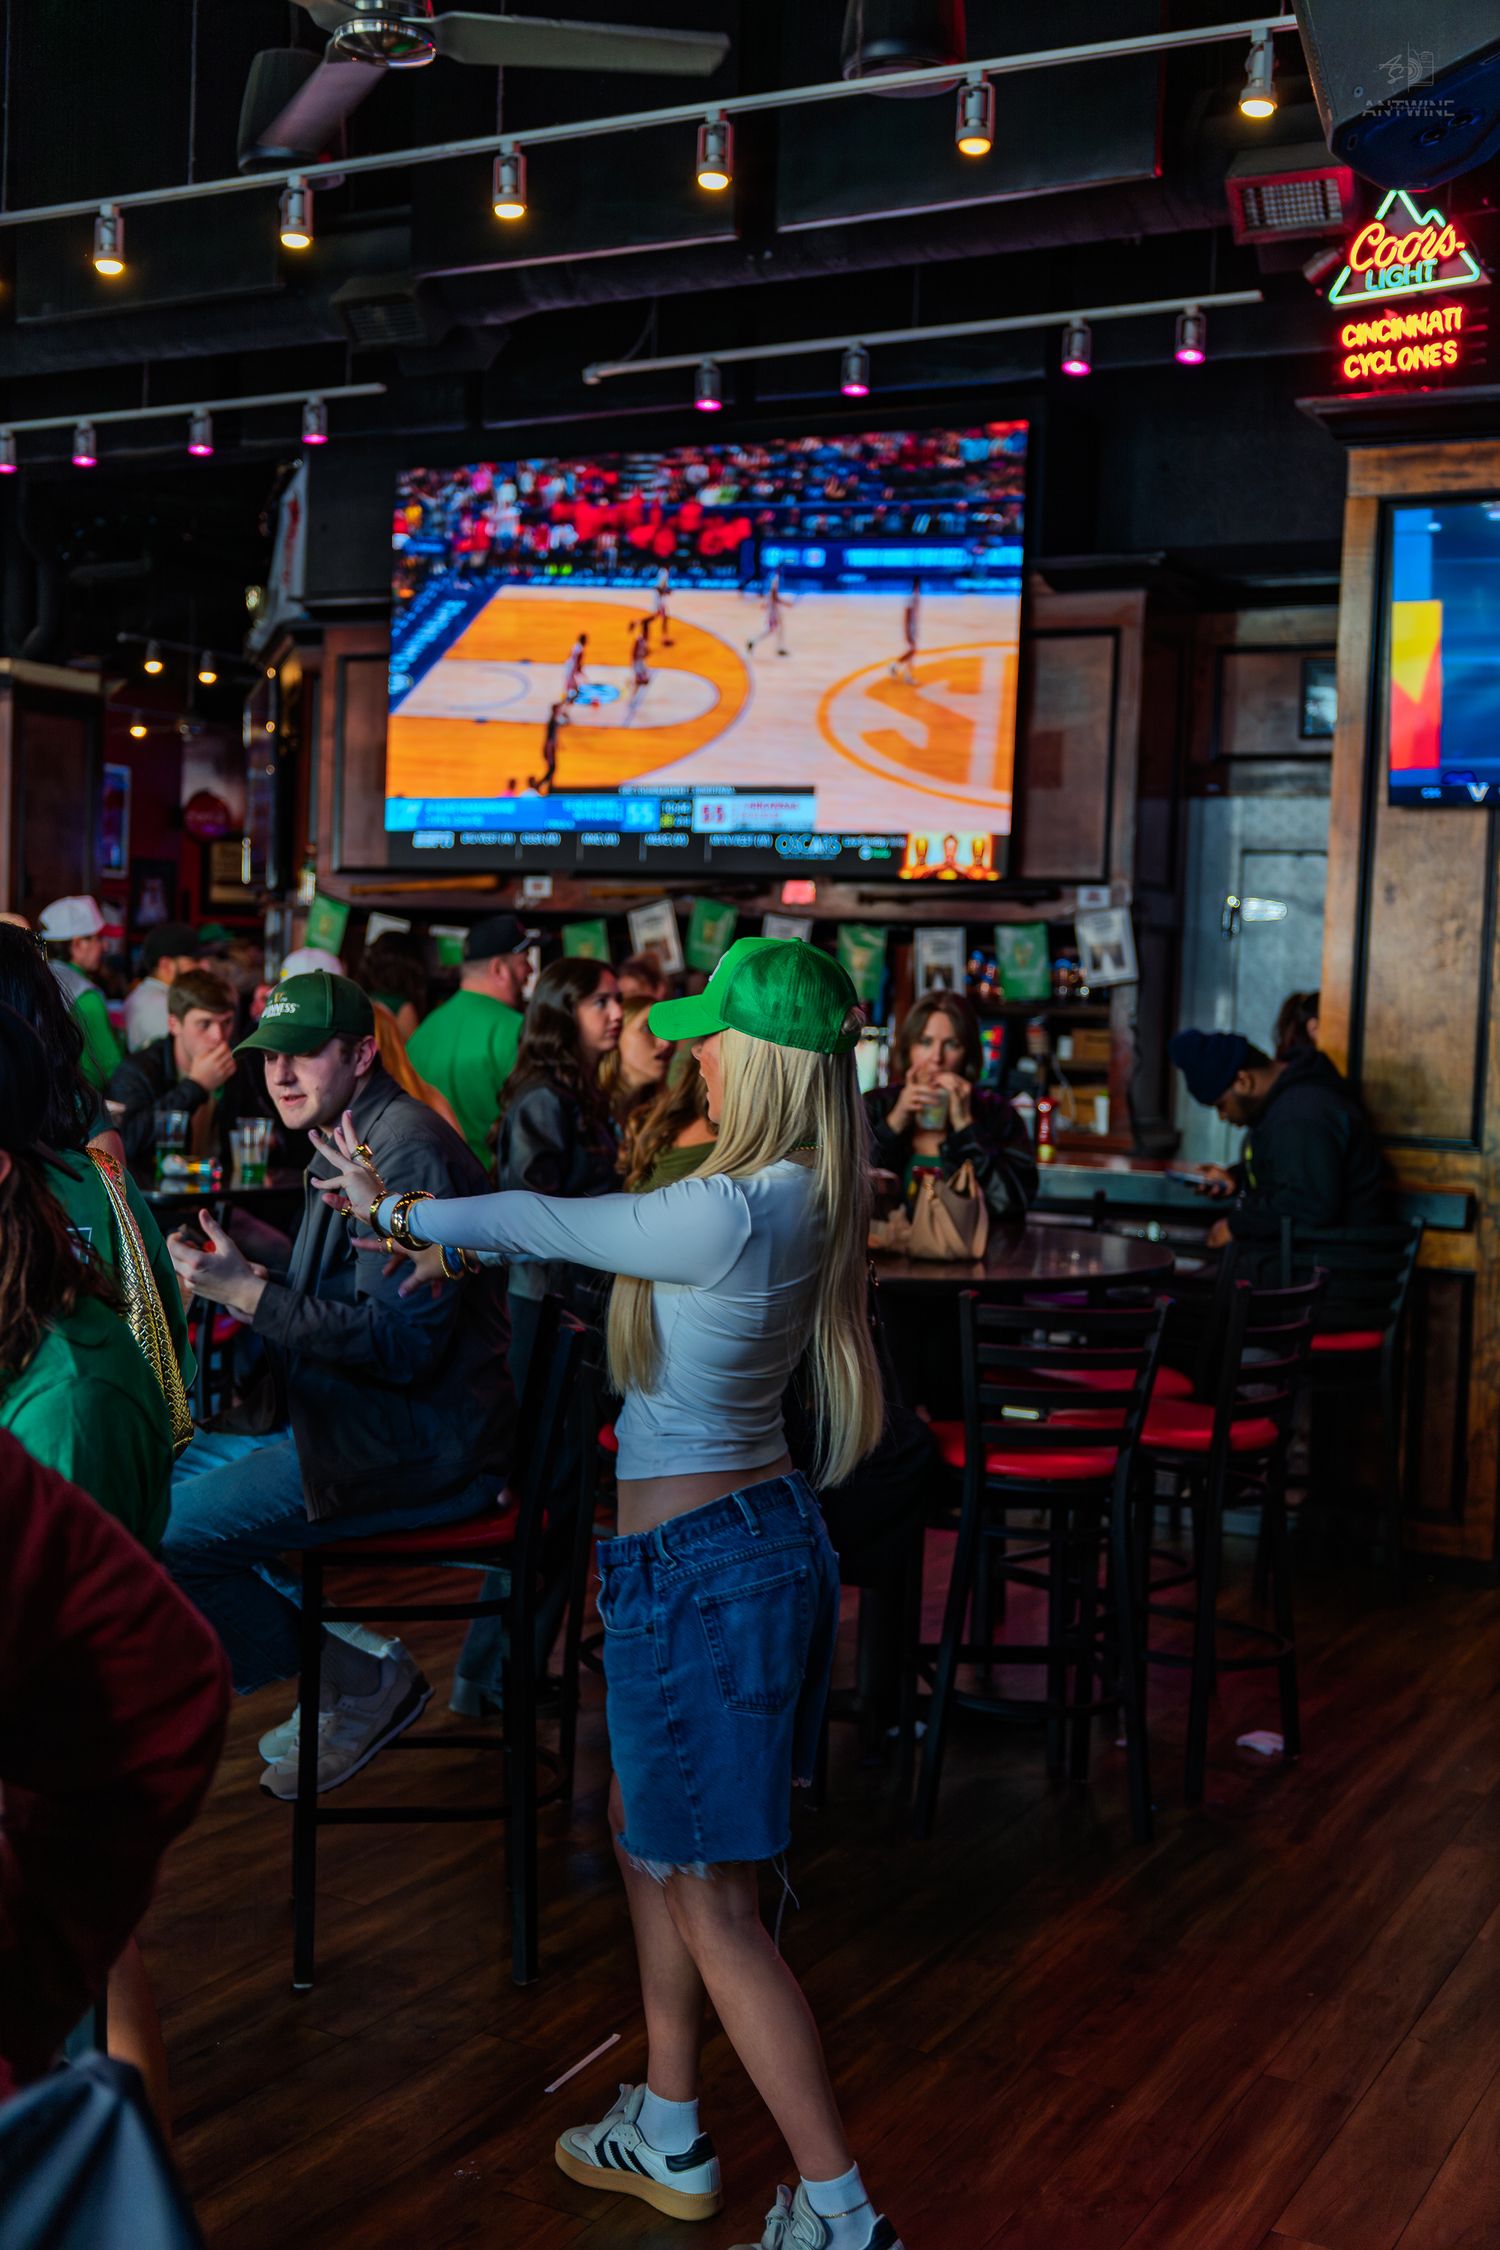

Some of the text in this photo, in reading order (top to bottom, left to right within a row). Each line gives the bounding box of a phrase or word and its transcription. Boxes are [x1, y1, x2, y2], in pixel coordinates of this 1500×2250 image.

[1350, 222, 1465, 271] Coors
[1365, 258, 1438, 291] LIGHT
[1341, 306, 1463, 348] CINCINNATI
[1343, 340, 1458, 378] CYCLONES
